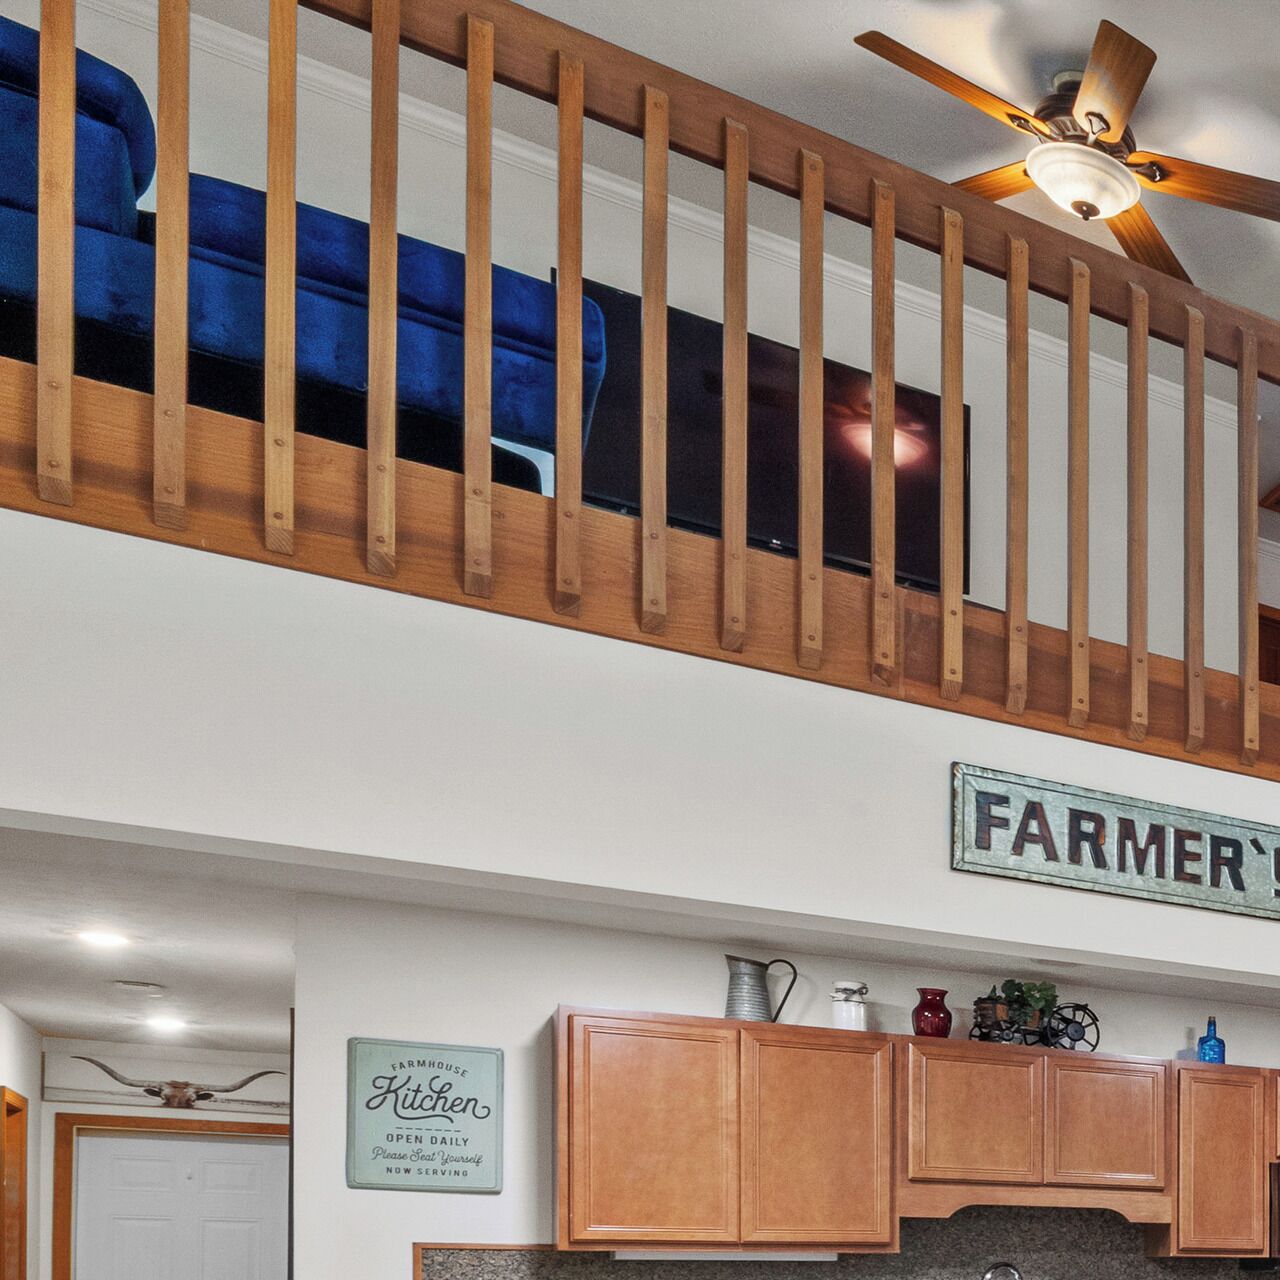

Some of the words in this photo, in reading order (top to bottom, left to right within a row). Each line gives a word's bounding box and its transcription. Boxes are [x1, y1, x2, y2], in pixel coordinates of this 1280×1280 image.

[391, 1059, 470, 1079] FARMHOUSE
[365, 1074, 491, 1124] Kitchen
[386, 1133, 423, 1144] OPEN
[430, 1135, 470, 1147] DAILY
[371, 1145, 409, 1161] Please
[409, 1148, 437, 1162] Seat
[437, 1150, 484, 1167] Yourself
[386, 1166, 412, 1175] NOW
[417, 1168, 469, 1177] SERVING
